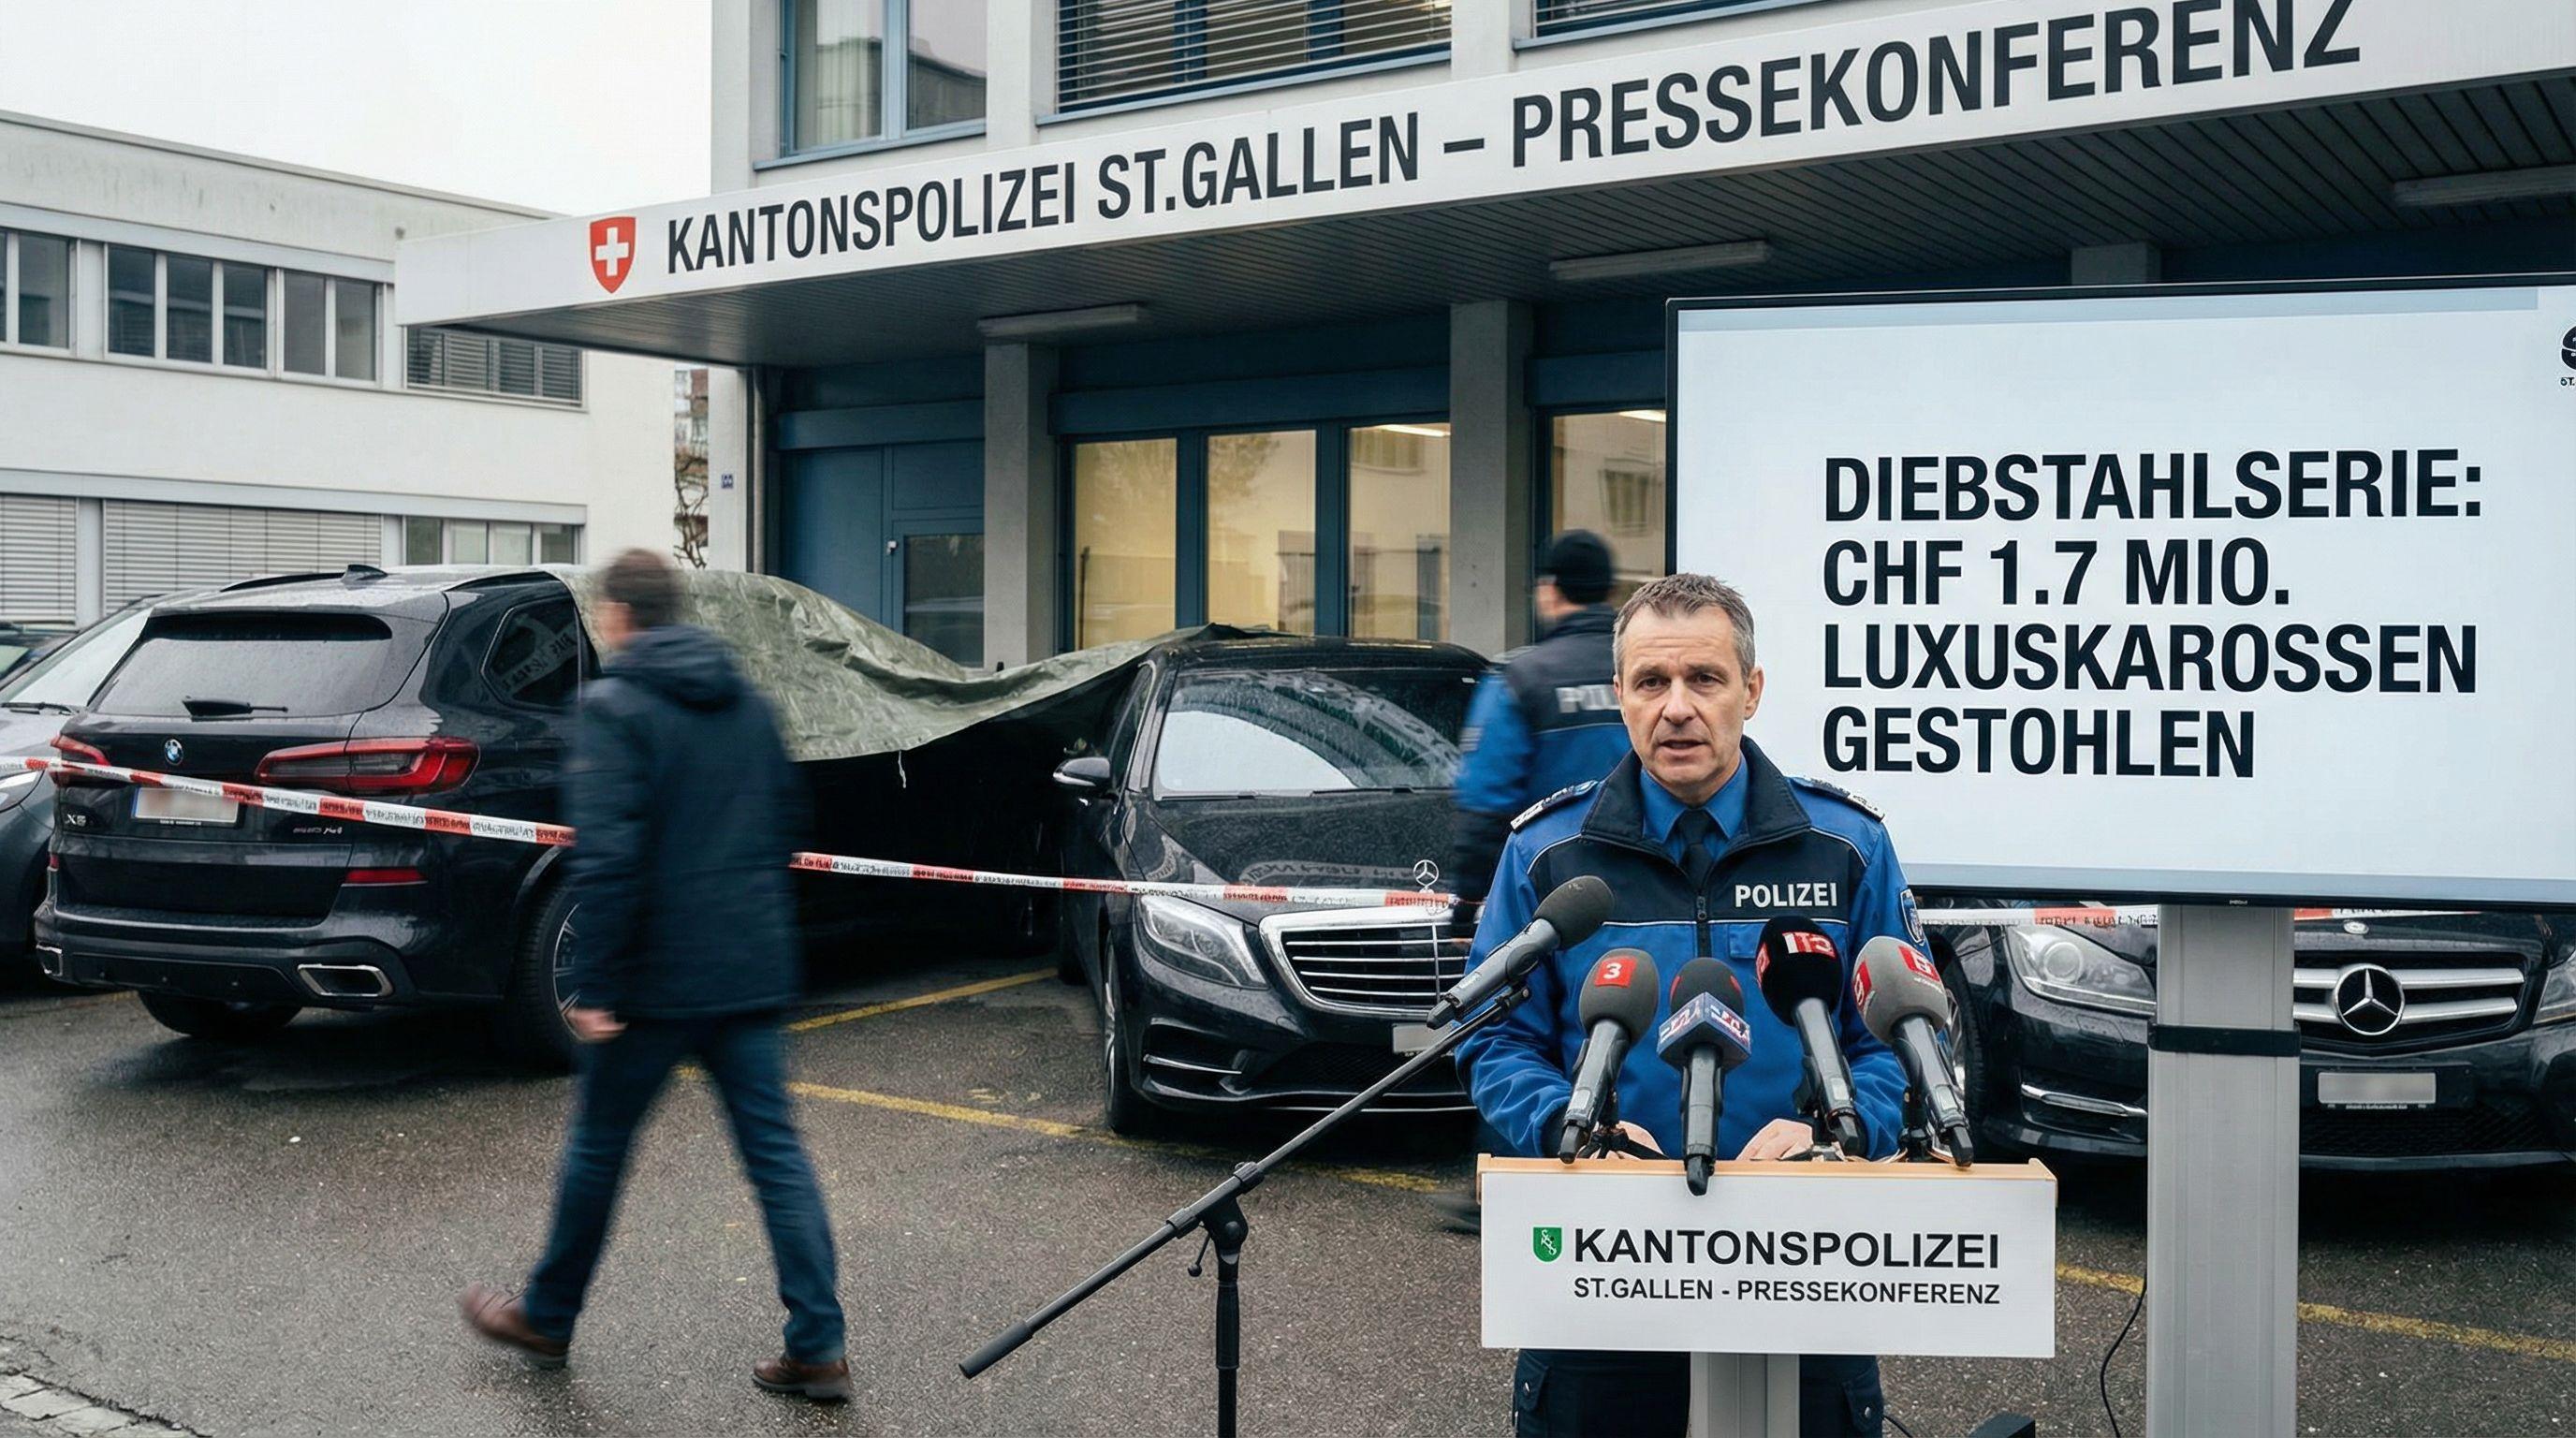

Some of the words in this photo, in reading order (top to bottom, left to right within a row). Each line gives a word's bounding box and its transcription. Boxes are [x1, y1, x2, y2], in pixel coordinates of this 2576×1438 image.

[668, 162, 1076, 273] KANTONSPOLIZEI
[1098, 111, 1417, 219] ST.GALLEN
[1514, 0, 2360, 168] PRESSEKONFERENZ
[1825, 449, 2481, 521] DIEBSTAHLSERIE:
[1823, 539, 1963, 607] CHF
[1990, 539, 2098, 605] 1.7
[2126, 536, 2290, 607] MIO.
[1824, 623, 2477, 694] LUXUSKAROSSEN
[1823, 706, 2254, 778] GESTOHLEN
[1735, 882, 1837, 908] POLIZEI
[1603, 961, 1622, 980] 3
[1575, 1228, 1998, 1269] KANTONSPOLIZEI
[1574, 1277, 1713, 1300] ST.GALLEN
[1737, 1280, 2000, 1305] PRESSEKONFERENZ
